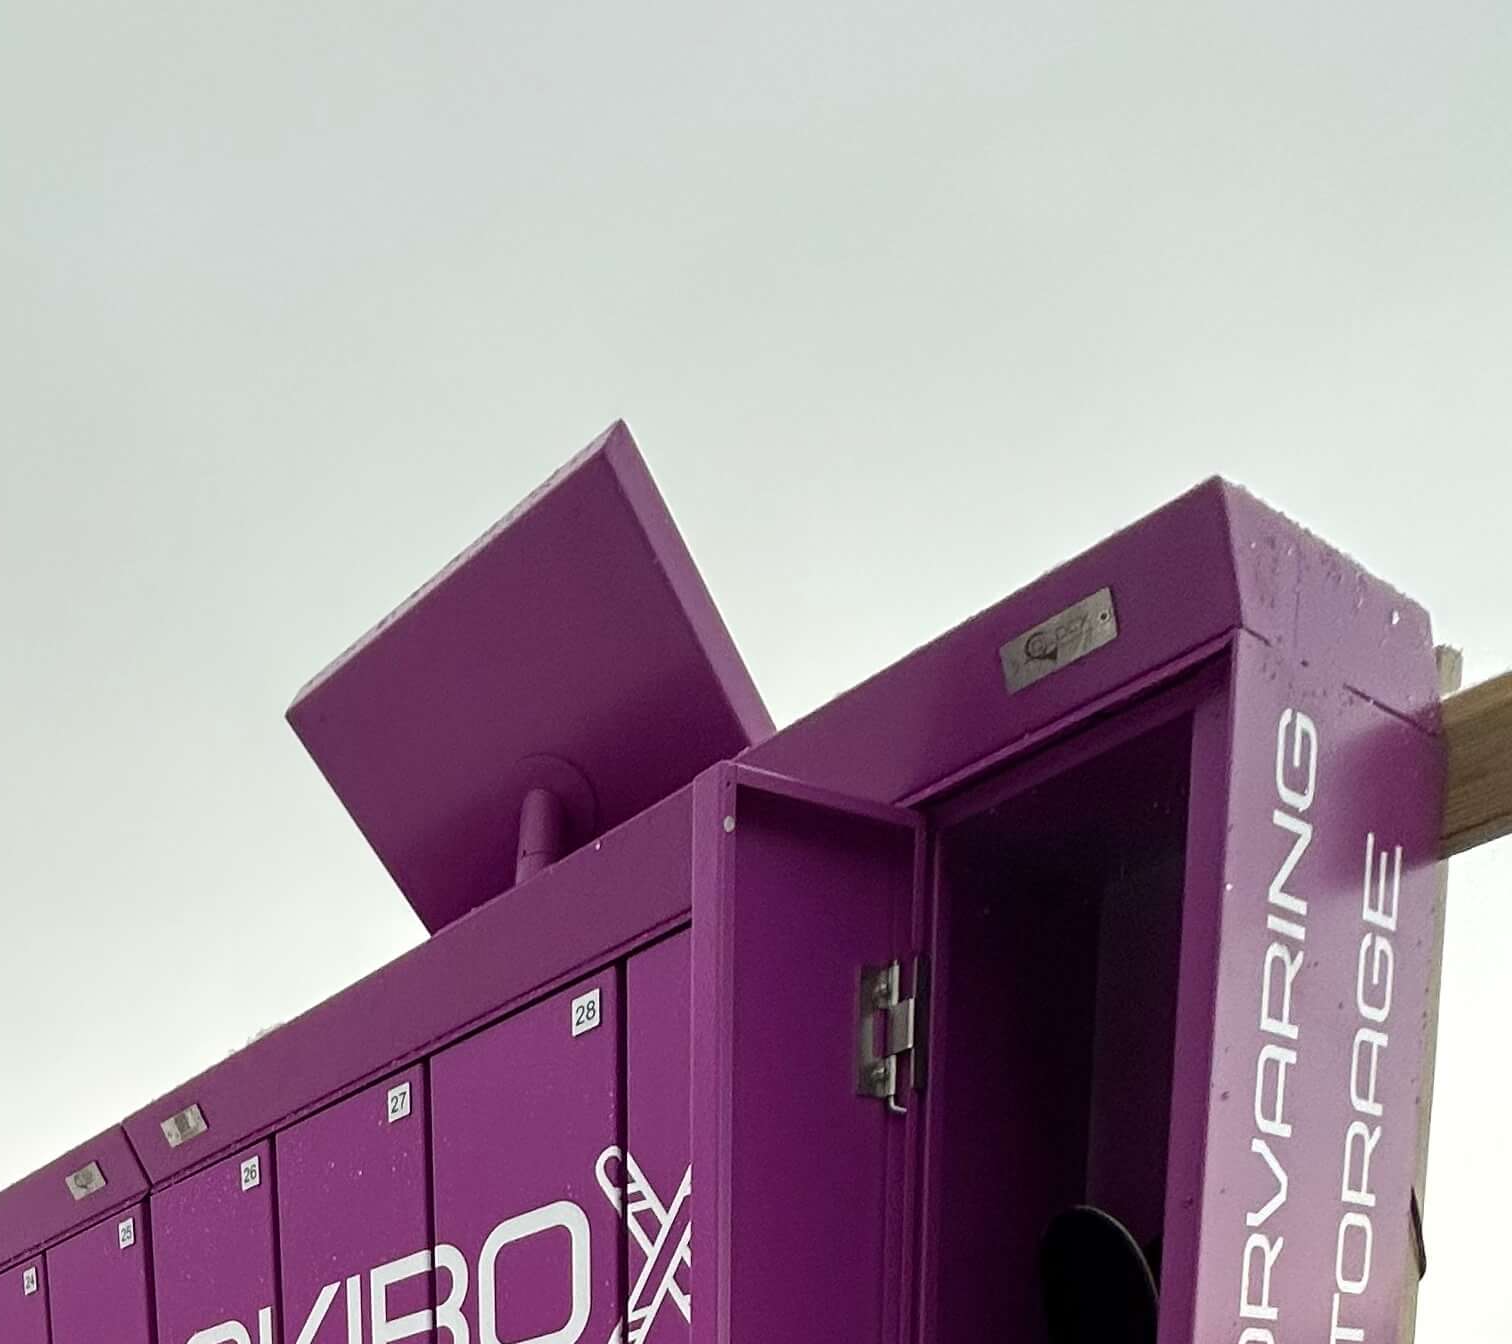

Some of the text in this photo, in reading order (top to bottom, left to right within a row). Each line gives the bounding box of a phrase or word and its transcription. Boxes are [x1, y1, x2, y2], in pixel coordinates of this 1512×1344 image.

[574, 1000, 596, 1027] 28
[390, 1091, 407, 1114] 27
[243, 1163, 257, 1184] 26
[120, 1224, 132, 1242] 25
